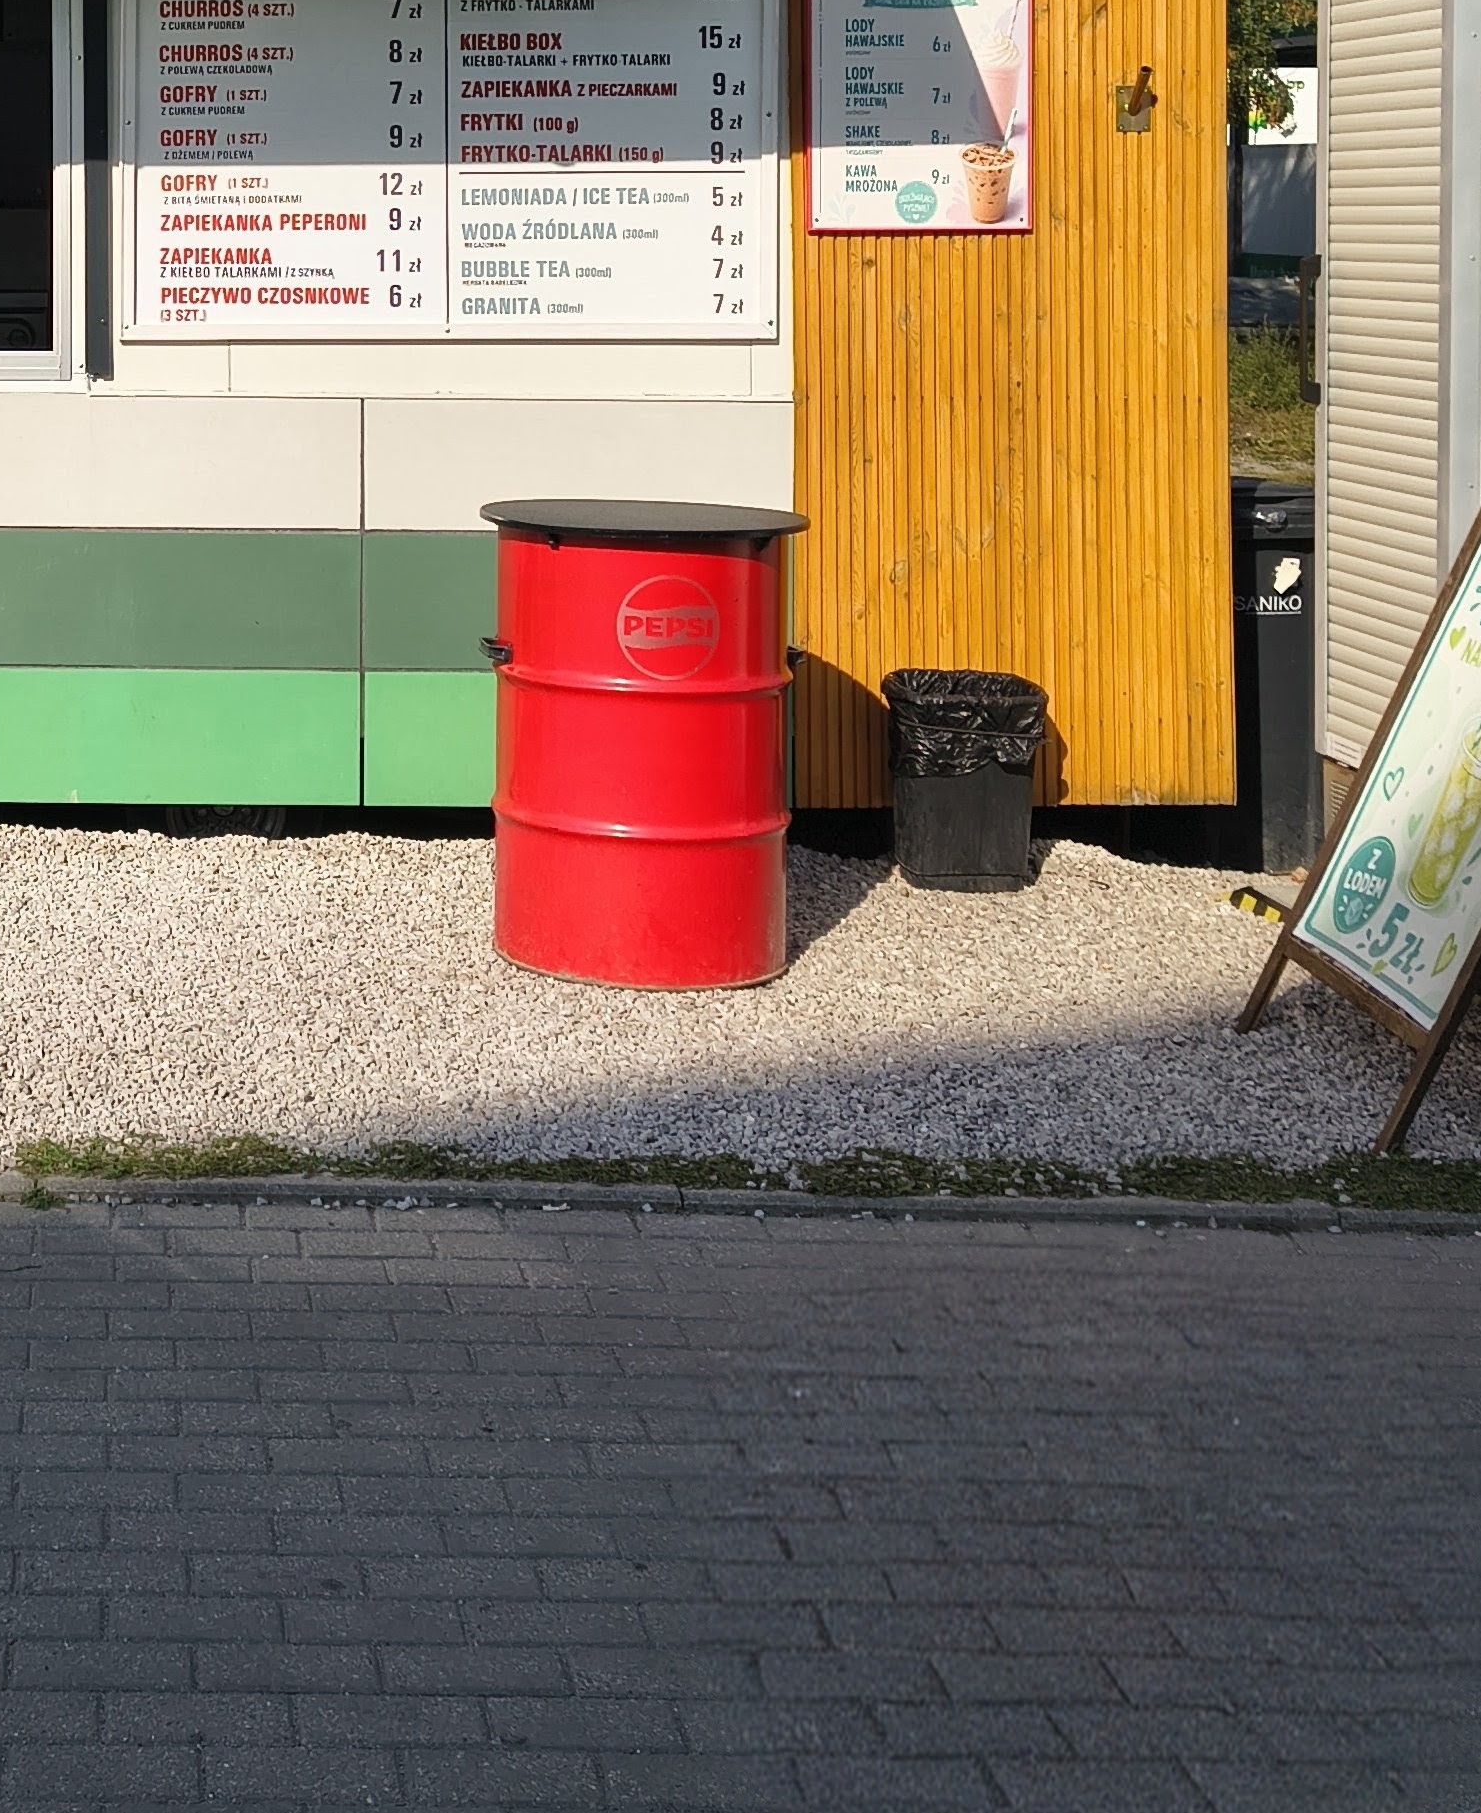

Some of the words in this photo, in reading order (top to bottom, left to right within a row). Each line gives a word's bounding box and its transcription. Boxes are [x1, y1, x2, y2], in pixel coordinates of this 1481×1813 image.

[160, 0, 244, 18] CHURROS
[263, 3, 294, 17] SZT.)
[409, 3, 422, 19] zł
[471, 0, 516, 11] FRYTKO
[527, 0, 595, 11] TALARKAMI
[169, 21, 205, 30] CUKREM
[845, 19, 874, 32] LODY
[460, 33, 521, 51] KIEŁBO
[526, 32, 562, 50] BOX
[698, 25, 722, 49] 15
[728, 34, 742, 49] zł
[845, 34, 904, 47] HAWAJSKIE
[933, 36, 940, 52] 6
[943, 41, 951, 52] zł
[159, 44, 243, 62] CHURROS
[262, 47, 293, 61] SZT.)
[389, 40, 402, 63] 8
[409, 48, 422, 63] zł
[845, 67, 874, 80] LODY
[389, 81, 403, 104] 7
[409, 89, 423, 105] zł
[461, 80, 572, 98] ZAPIEKANKA
[588, 83, 677, 96] PIECZARKAMI
[712, 72, 726, 96] 9
[732, 81, 745, 96] zł
[845, 82, 904, 95] HAWAJSKIE
[160, 85, 218, 103] GOFRY
[240, 89, 267, 101] SZT.)
[846, 98, 850, 106] Z
[854, 97, 887, 109] POLEWĄ
[933, 88, 940, 104] 7
[942, 93, 950, 103] zł
[169, 106, 205, 116] CUKREM
[710, 107, 724, 131] 8
[730, 114, 742, 129] zł
[460, 113, 523, 131] FRYTKI
[533, 118, 562, 132] (100
[160, 129, 218, 147] GOFRY
[240, 133, 267, 145] SZT.)
[389, 125, 403, 148] 9
[409, 133, 423, 148] zł
[845, 126, 880, 138] SHAKE
[931, 129, 939, 144] 8
[942, 135, 950, 144] zł
[461, 144, 612, 163] FRYTKO-TALARKI
[619, 147, 648, 162] (150
[710, 141, 724, 165] 9
[730, 148, 742, 163] zł
[845, 165, 877, 177] KAWA
[932, 169, 940, 184] 9
[942, 174, 950, 184] zł
[161, 175, 218, 192] GOFRY
[241, 177, 269, 189] SZT.)
[379, 173, 403, 196] 12
[410, 180, 423, 196] zł
[845, 178, 898, 192] MROŻONA
[461, 188, 567, 206] LEMONIADA
[583, 188, 610, 205] ICE
[616, 187, 650, 204] TEA
[712, 186, 724, 206] 5
[730, 192, 743, 206] zł
[160, 214, 273, 231] ZAPIEKANKA
[279, 213, 366, 230] PEPERONI
[389, 208, 402, 230] 9
[409, 216, 422, 231] zł
[461, 223, 517, 241] WODA
[522, 219, 617, 240] ŹRÓDLANA
[711, 225, 724, 245] 4
[730, 230, 743, 245] zł
[160, 248, 272, 265] ZAPIEKANKA
[376, 249, 401, 272] 11
[408, 258, 421, 272] zł
[215, 267, 281, 278] TALARKAMI
[461, 260, 530, 278] BUBBLE
[536, 260, 570, 278] TEA
[713, 258, 724, 278] 7
[730, 264, 744, 279] zł
[161, 287, 251, 304] PIECZYWO
[258, 287, 370, 304] CZOSNKOWE
[389, 284, 402, 308] 6
[409, 293, 422, 308] zł
[713, 294, 724, 314] 7
[731, 299, 744, 314] zł
[462, 297, 541, 315] GRANITA
[1235, 594, 1302, 612] SANIKO
[624, 616, 714, 638] PEPSI
[1368, 848, 1383, 870] Z
[1343, 868, 1387, 899] LODEM
[1368, 902, 1410, 958] 5
